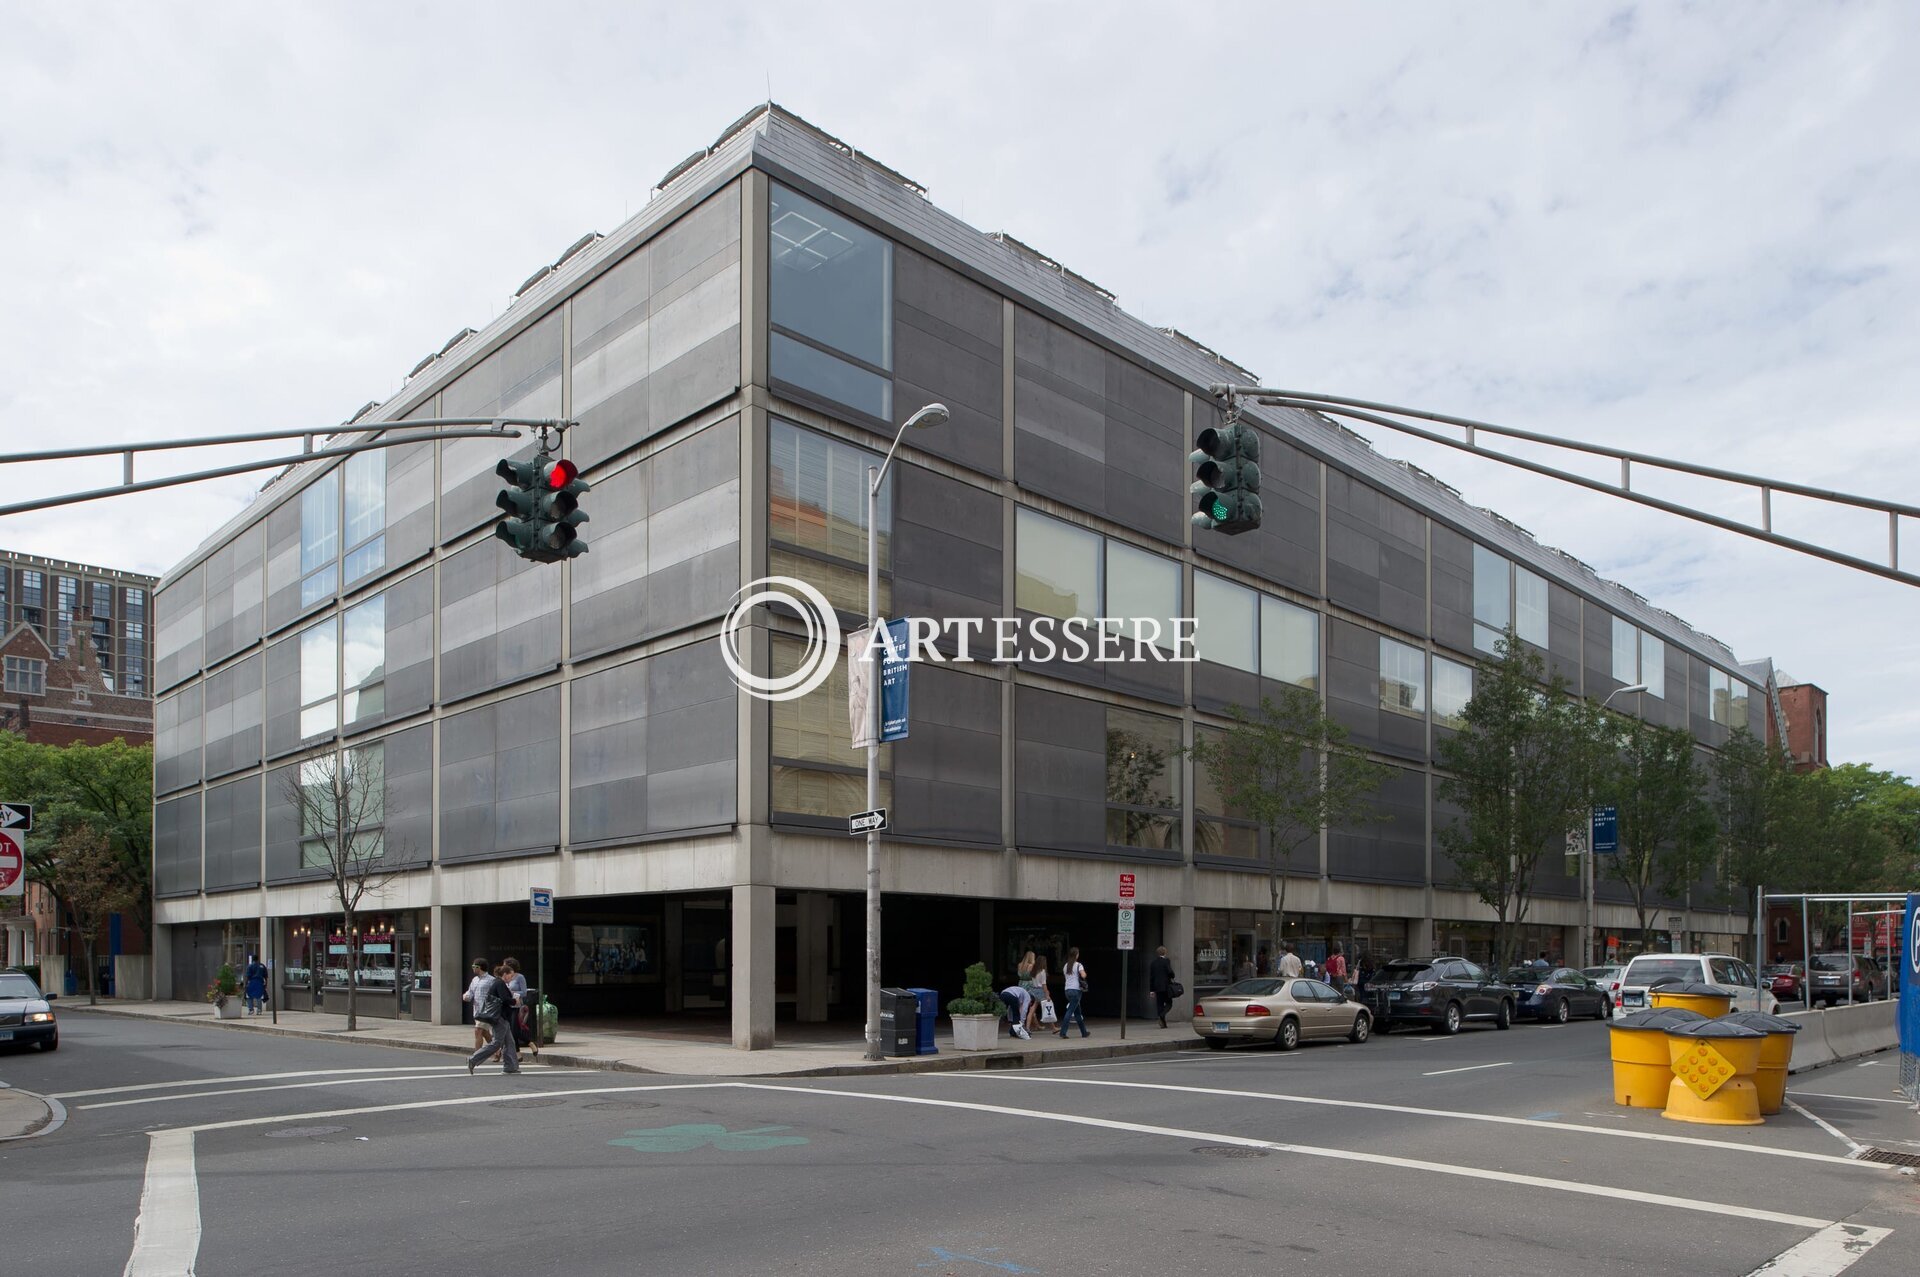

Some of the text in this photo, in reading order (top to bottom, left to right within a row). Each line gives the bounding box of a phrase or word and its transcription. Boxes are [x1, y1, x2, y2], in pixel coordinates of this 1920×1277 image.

[883, 643, 906, 655] CTER
[883, 664, 908, 676] BRITISH
[883, 678, 896, 686] ART
[855, 816, 879, 827] ONE WAY
[1045, 1005, 1053, 1016] Y
